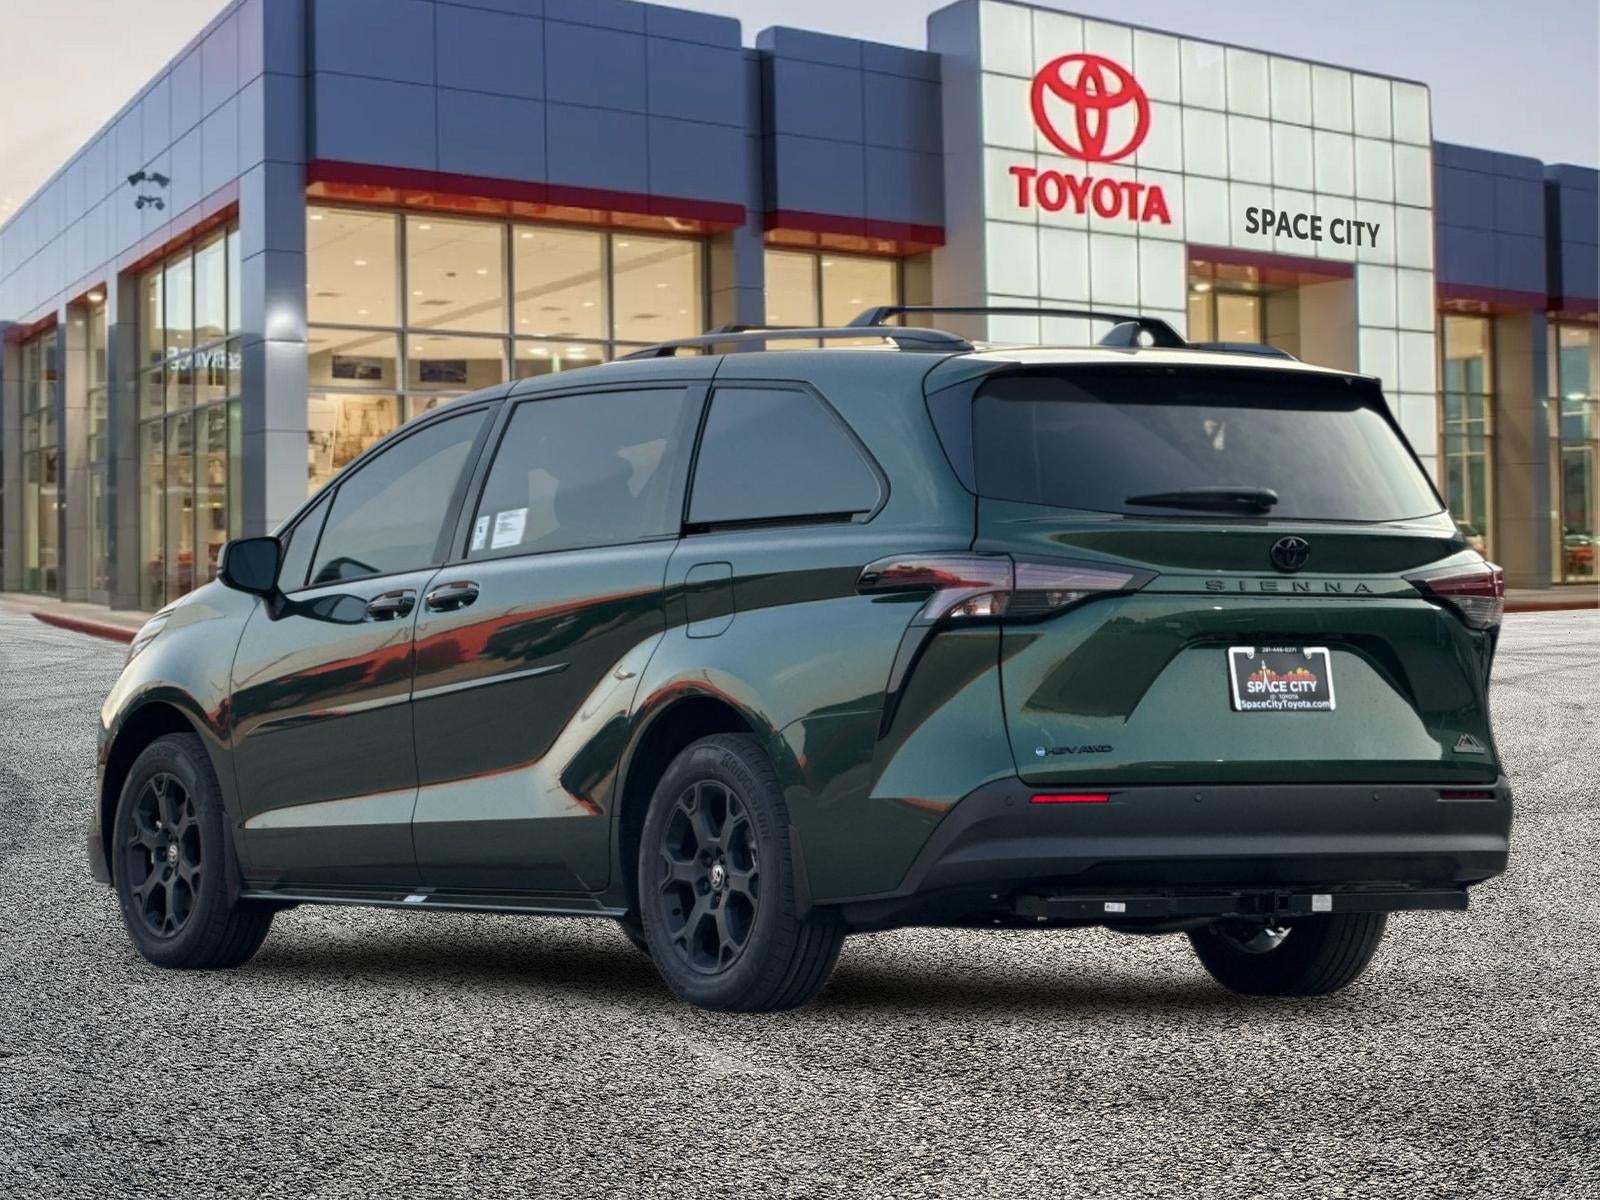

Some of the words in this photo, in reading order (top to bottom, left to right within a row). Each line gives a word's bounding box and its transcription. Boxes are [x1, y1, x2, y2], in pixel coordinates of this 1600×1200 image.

[1009, 166, 1172, 225] TOYOTA
[1245, 206, 1323, 241] SPACE
[1329, 219, 1381, 248] CITY
[1204, 579, 1374, 594] SIENNA
[1247, 680, 1288, 694] SPACE
[1289, 680, 1318, 693] CITY
[1278, 693, 1299, 701] TOYOTA
[1241, 699, 1330, 710] SpaceCityToyota.com
